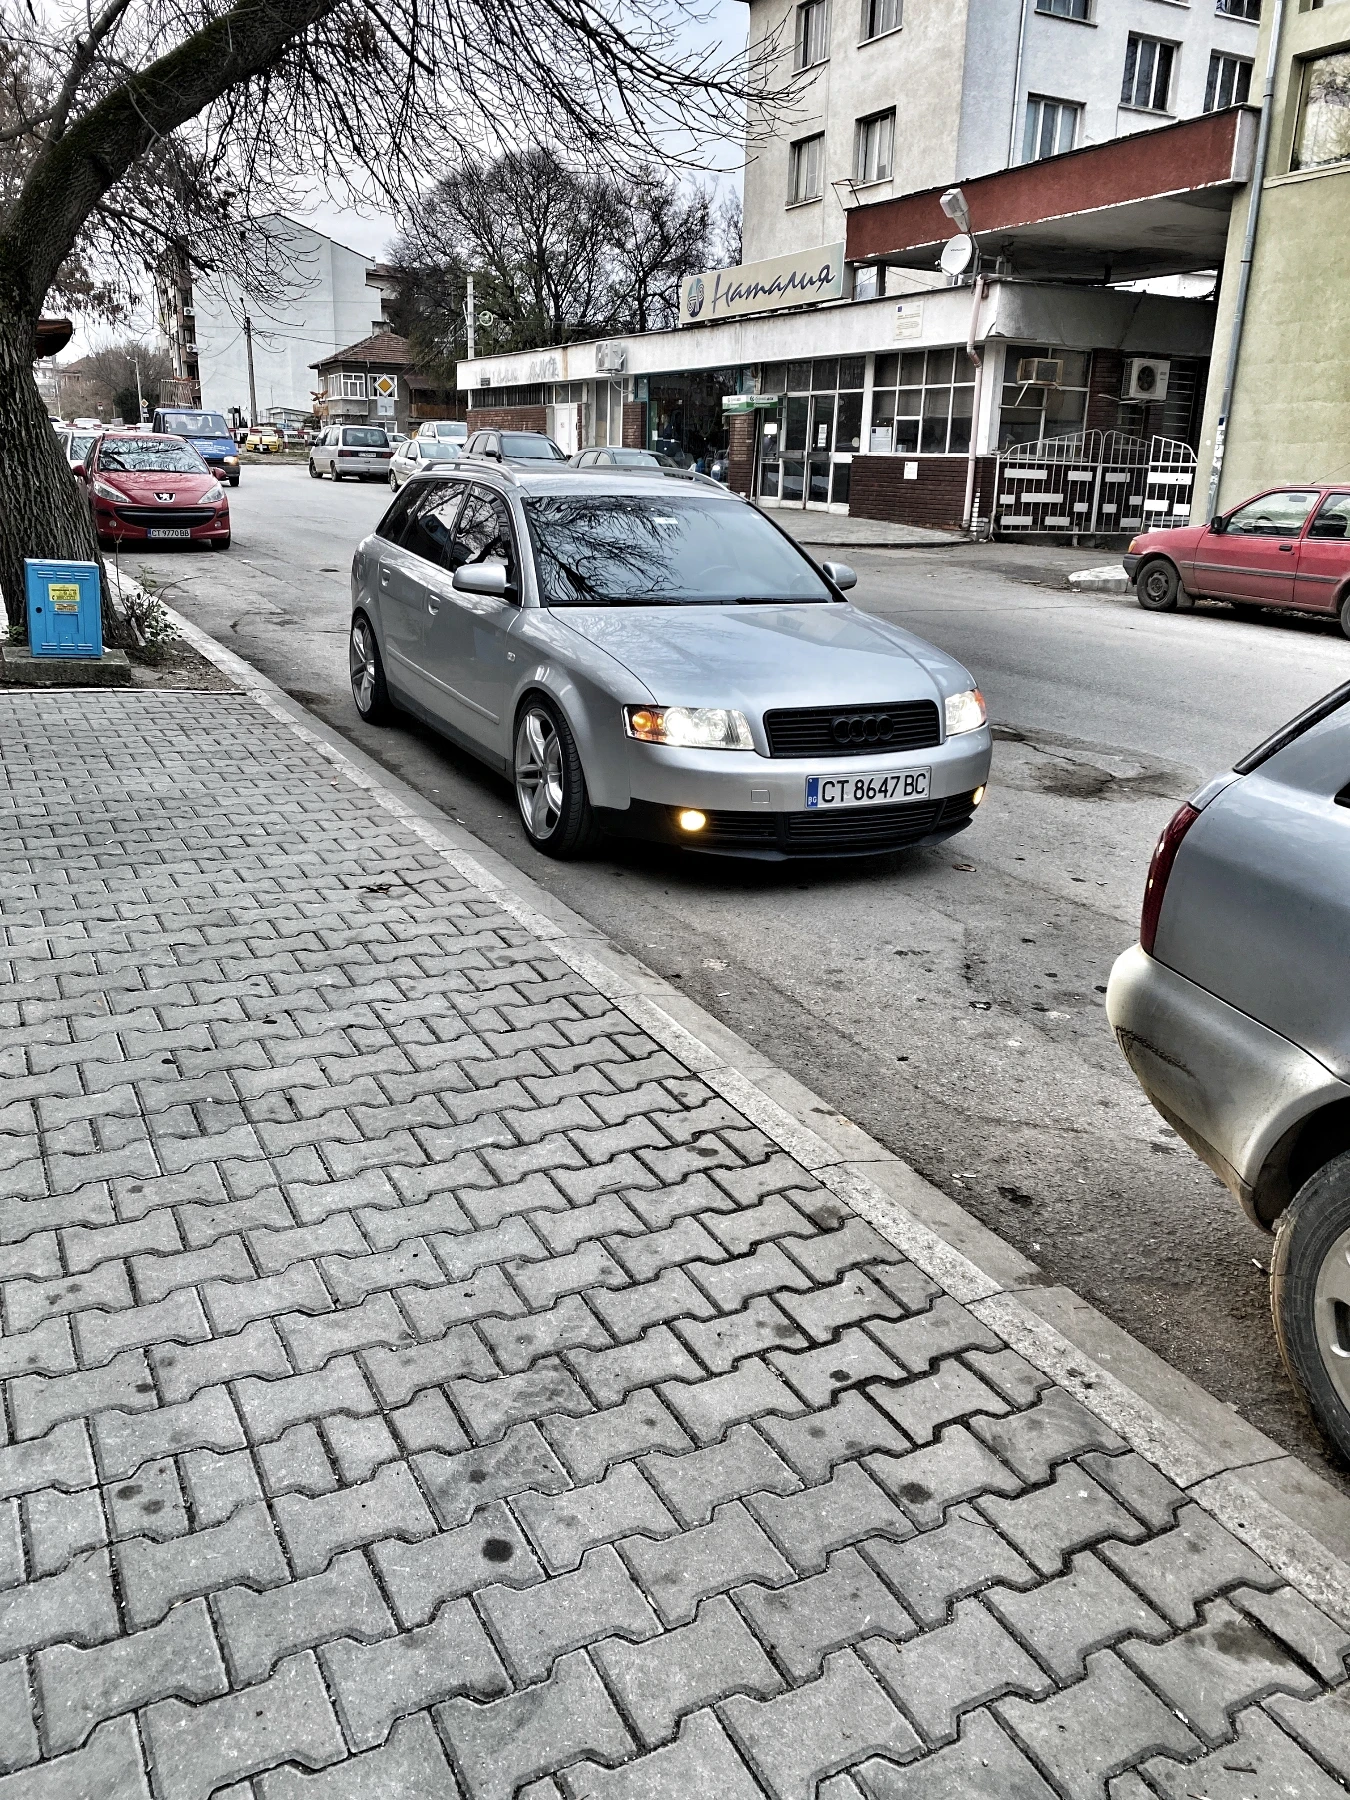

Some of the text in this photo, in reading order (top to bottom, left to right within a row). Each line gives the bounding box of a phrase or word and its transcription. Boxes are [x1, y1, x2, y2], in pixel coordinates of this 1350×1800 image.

[712, 264, 835, 314] Наталия
[808, 796, 817, 805] BG
[822, 773, 927, 803] CT 8647 BC
